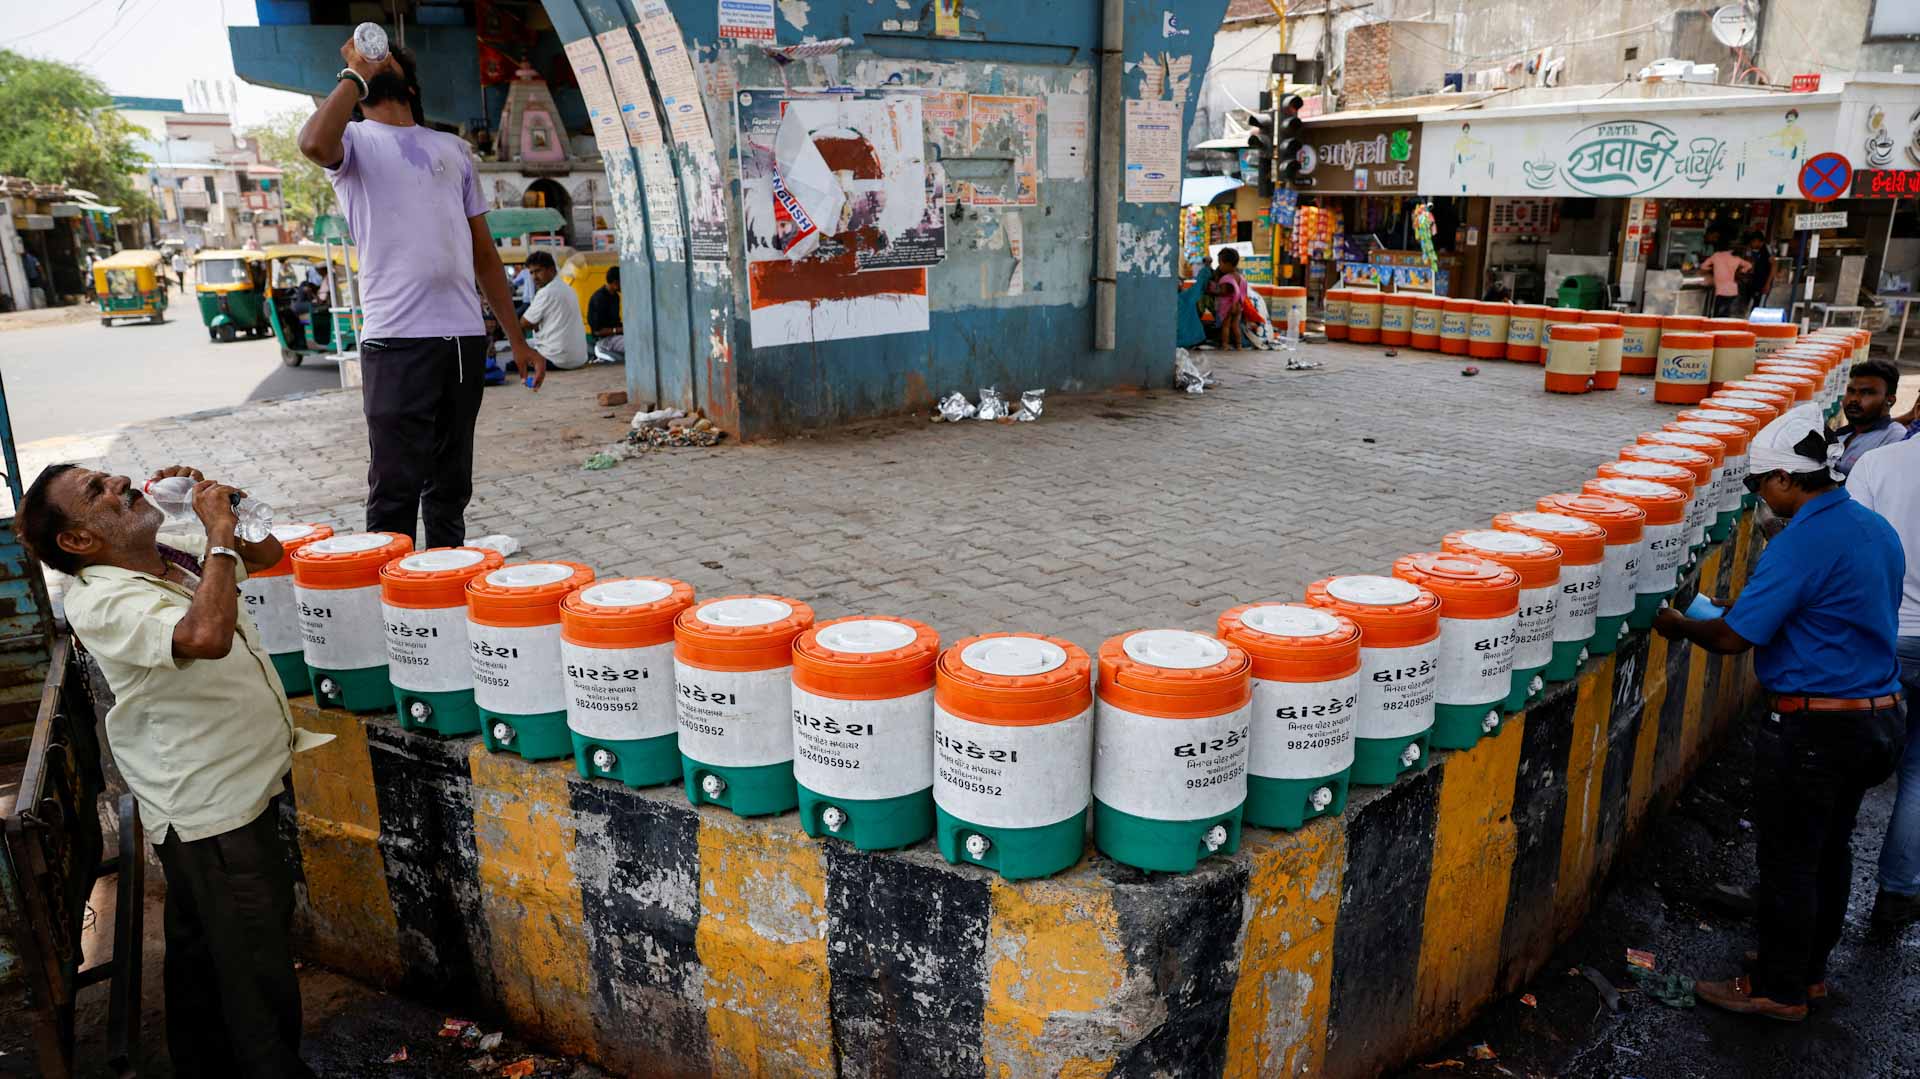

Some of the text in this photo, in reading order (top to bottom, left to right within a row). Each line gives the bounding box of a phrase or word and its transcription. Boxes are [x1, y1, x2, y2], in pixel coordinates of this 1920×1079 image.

[576, 697, 640, 711] 9824095952
[1287, 731, 1350, 750] 9824095952
[799, 746, 860, 769] 9824095952
[940, 767, 1003, 797] 9824095952
